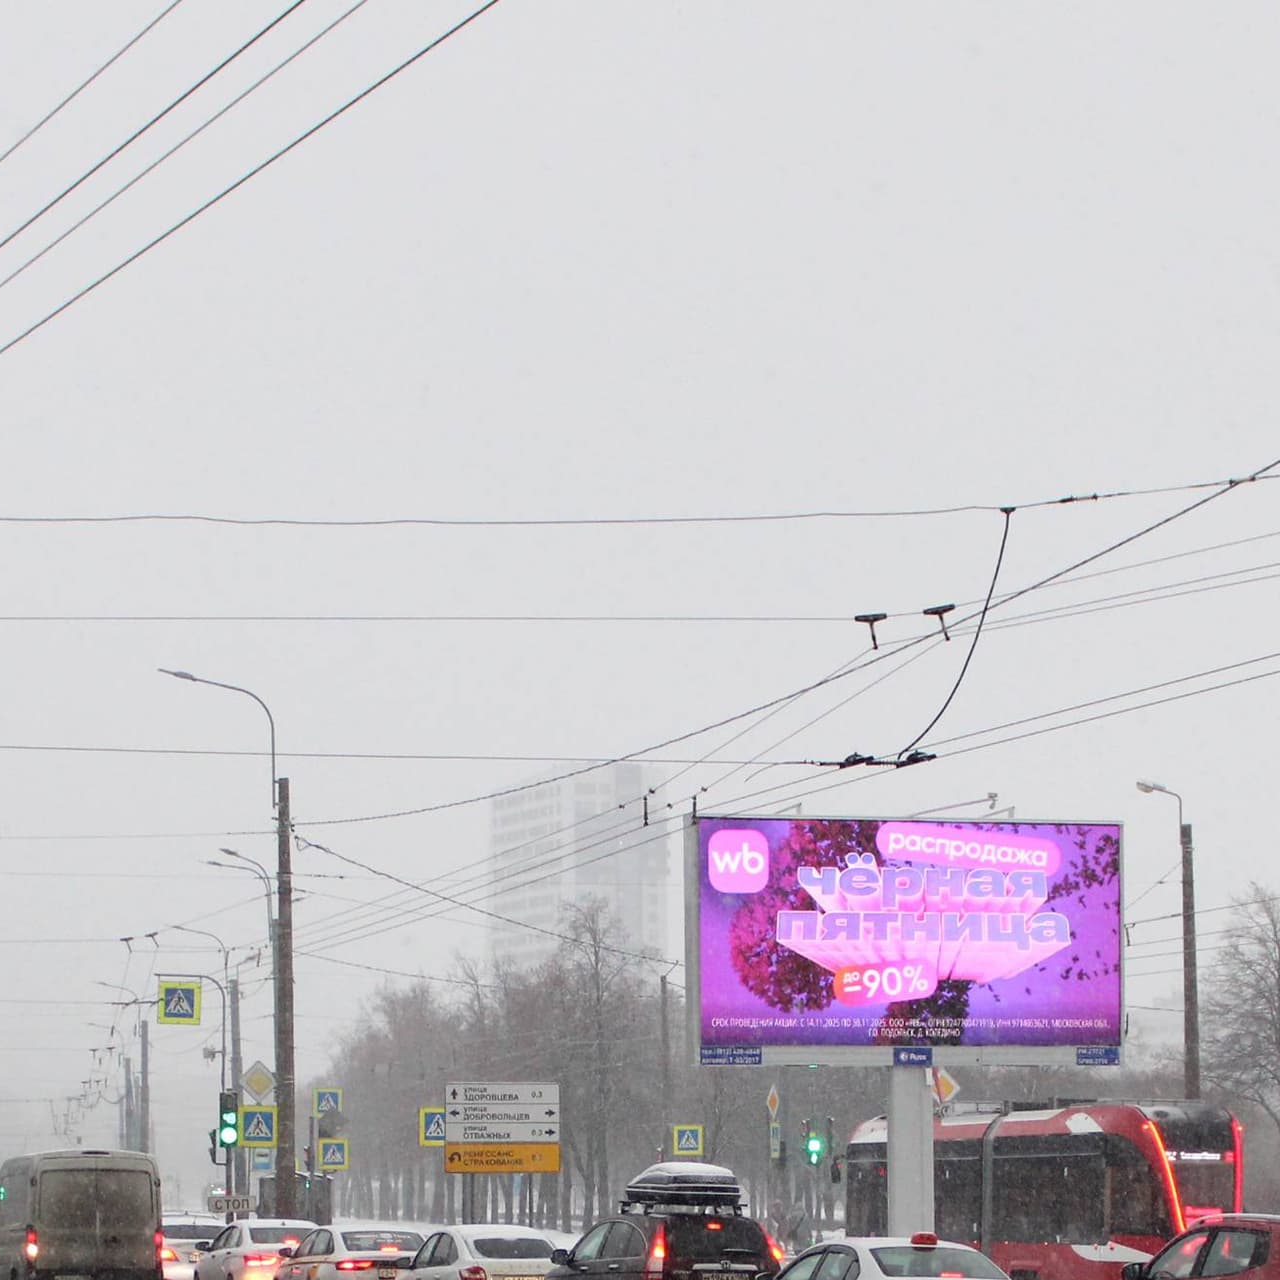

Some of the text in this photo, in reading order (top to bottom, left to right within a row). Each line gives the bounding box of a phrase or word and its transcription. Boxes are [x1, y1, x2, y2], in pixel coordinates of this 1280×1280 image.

[887, 832, 1049, 867] распродажа
[711, 842, 765, 874] wb
[797, 852, 1048, 909] чёрная
[776, 910, 1071, 951] пятница
[463, 1086, 488, 1094] улица
[463, 1093, 519, 1102] ЗДОРОВЦЕВА
[463, 1113, 530, 1121] ДОБРОВОЛЬЦЕВ
[463, 1132, 511, 1140] ОТВАЖНЫХ
[214, 1198, 250, 1210] СТОП
